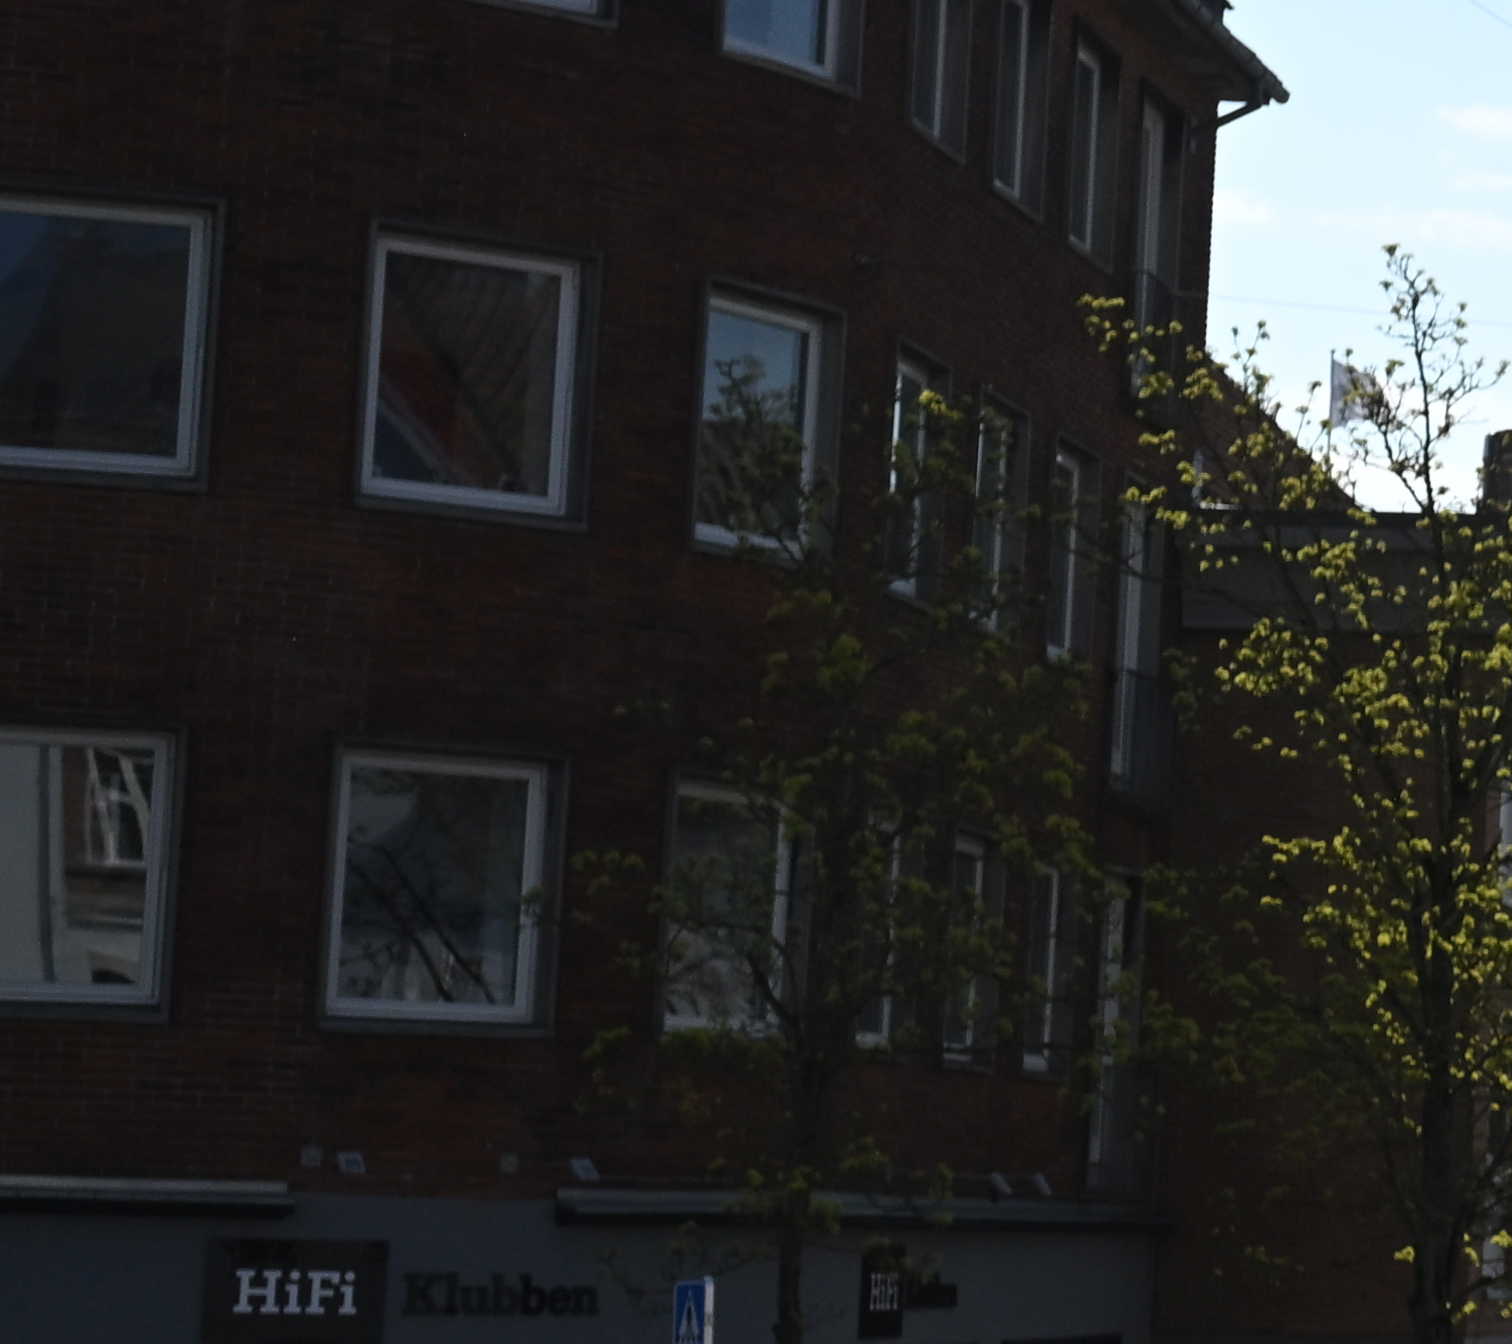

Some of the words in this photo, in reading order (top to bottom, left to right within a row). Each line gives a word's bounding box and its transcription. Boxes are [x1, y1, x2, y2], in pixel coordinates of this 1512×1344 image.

[232, 1268, 357, 1316] HiFi
[402, 1272, 600, 1319] Klubben
[868, 1271, 899, 1312] HiFi
